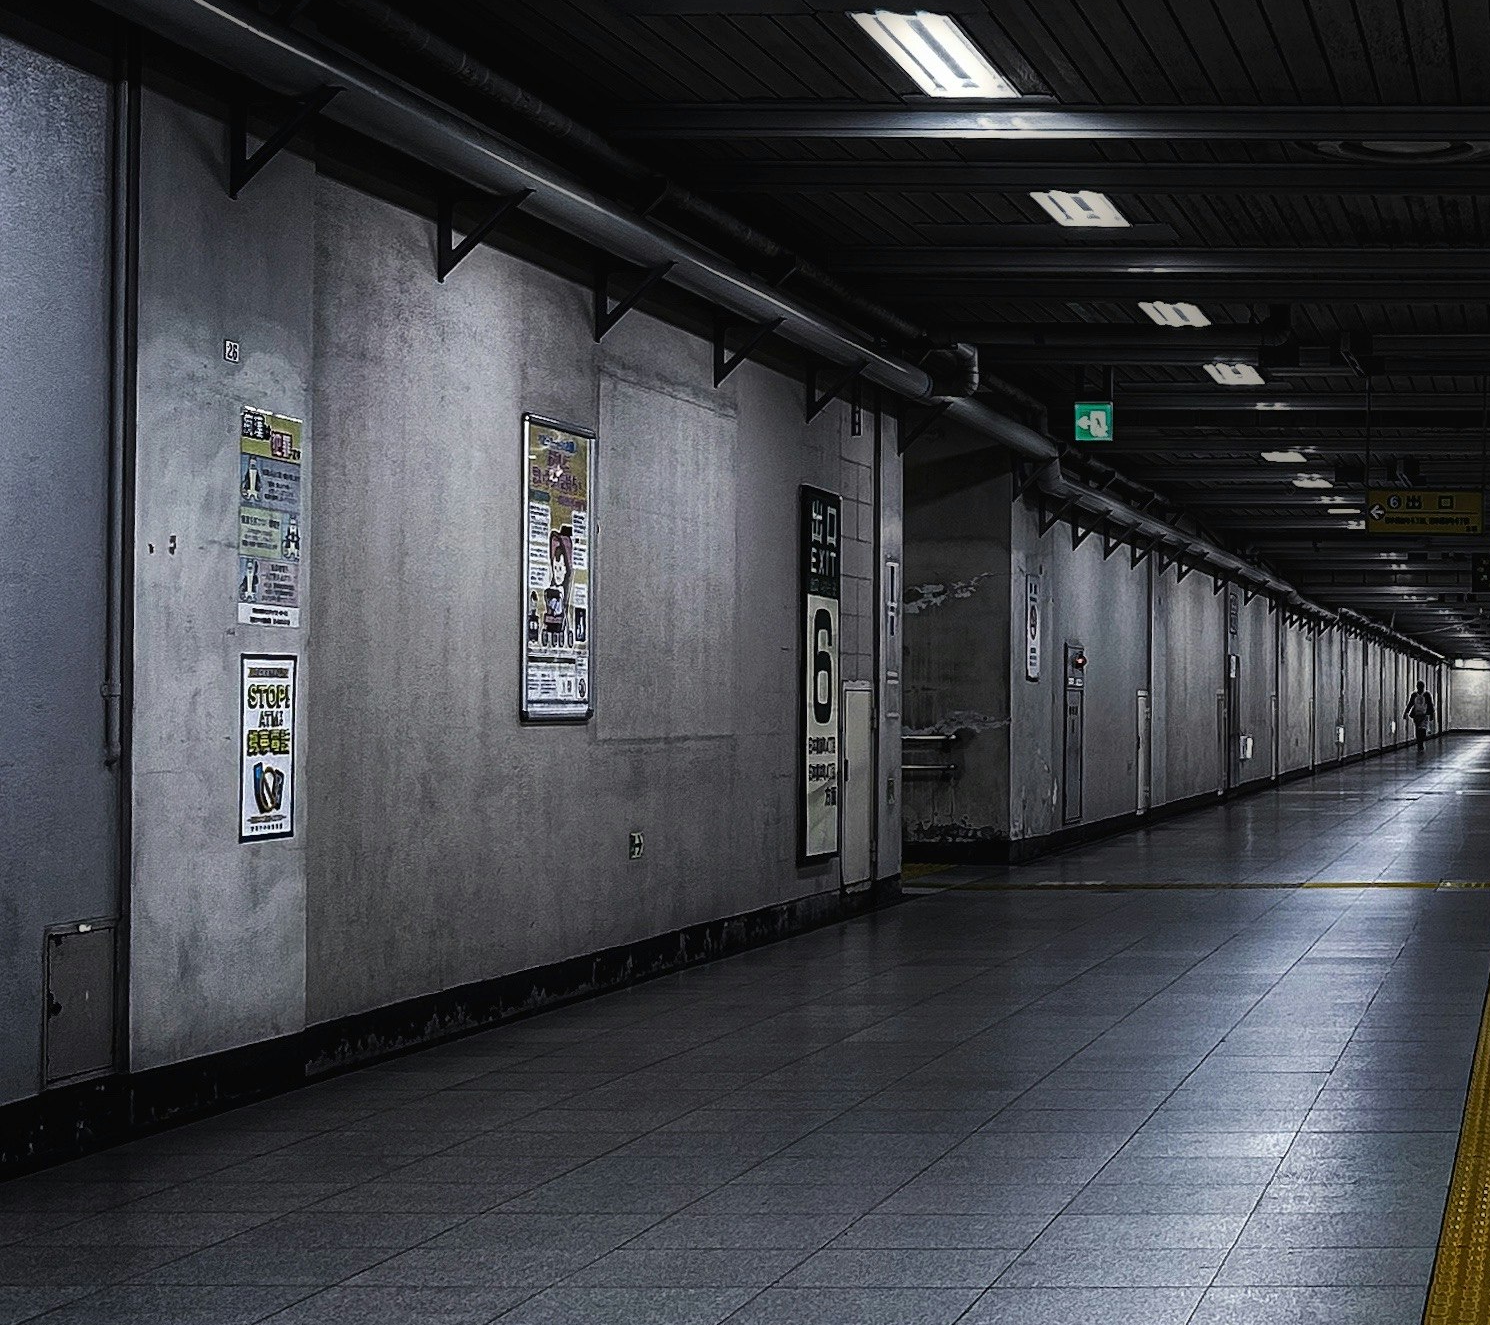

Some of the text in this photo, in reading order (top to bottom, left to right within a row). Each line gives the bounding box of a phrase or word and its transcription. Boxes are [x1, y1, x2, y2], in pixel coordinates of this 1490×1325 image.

[226, 344, 238, 361] 26
[811, 499, 837, 548] 出口
[811, 547, 837, 577] EXIT
[814, 608, 833, 725] 6
